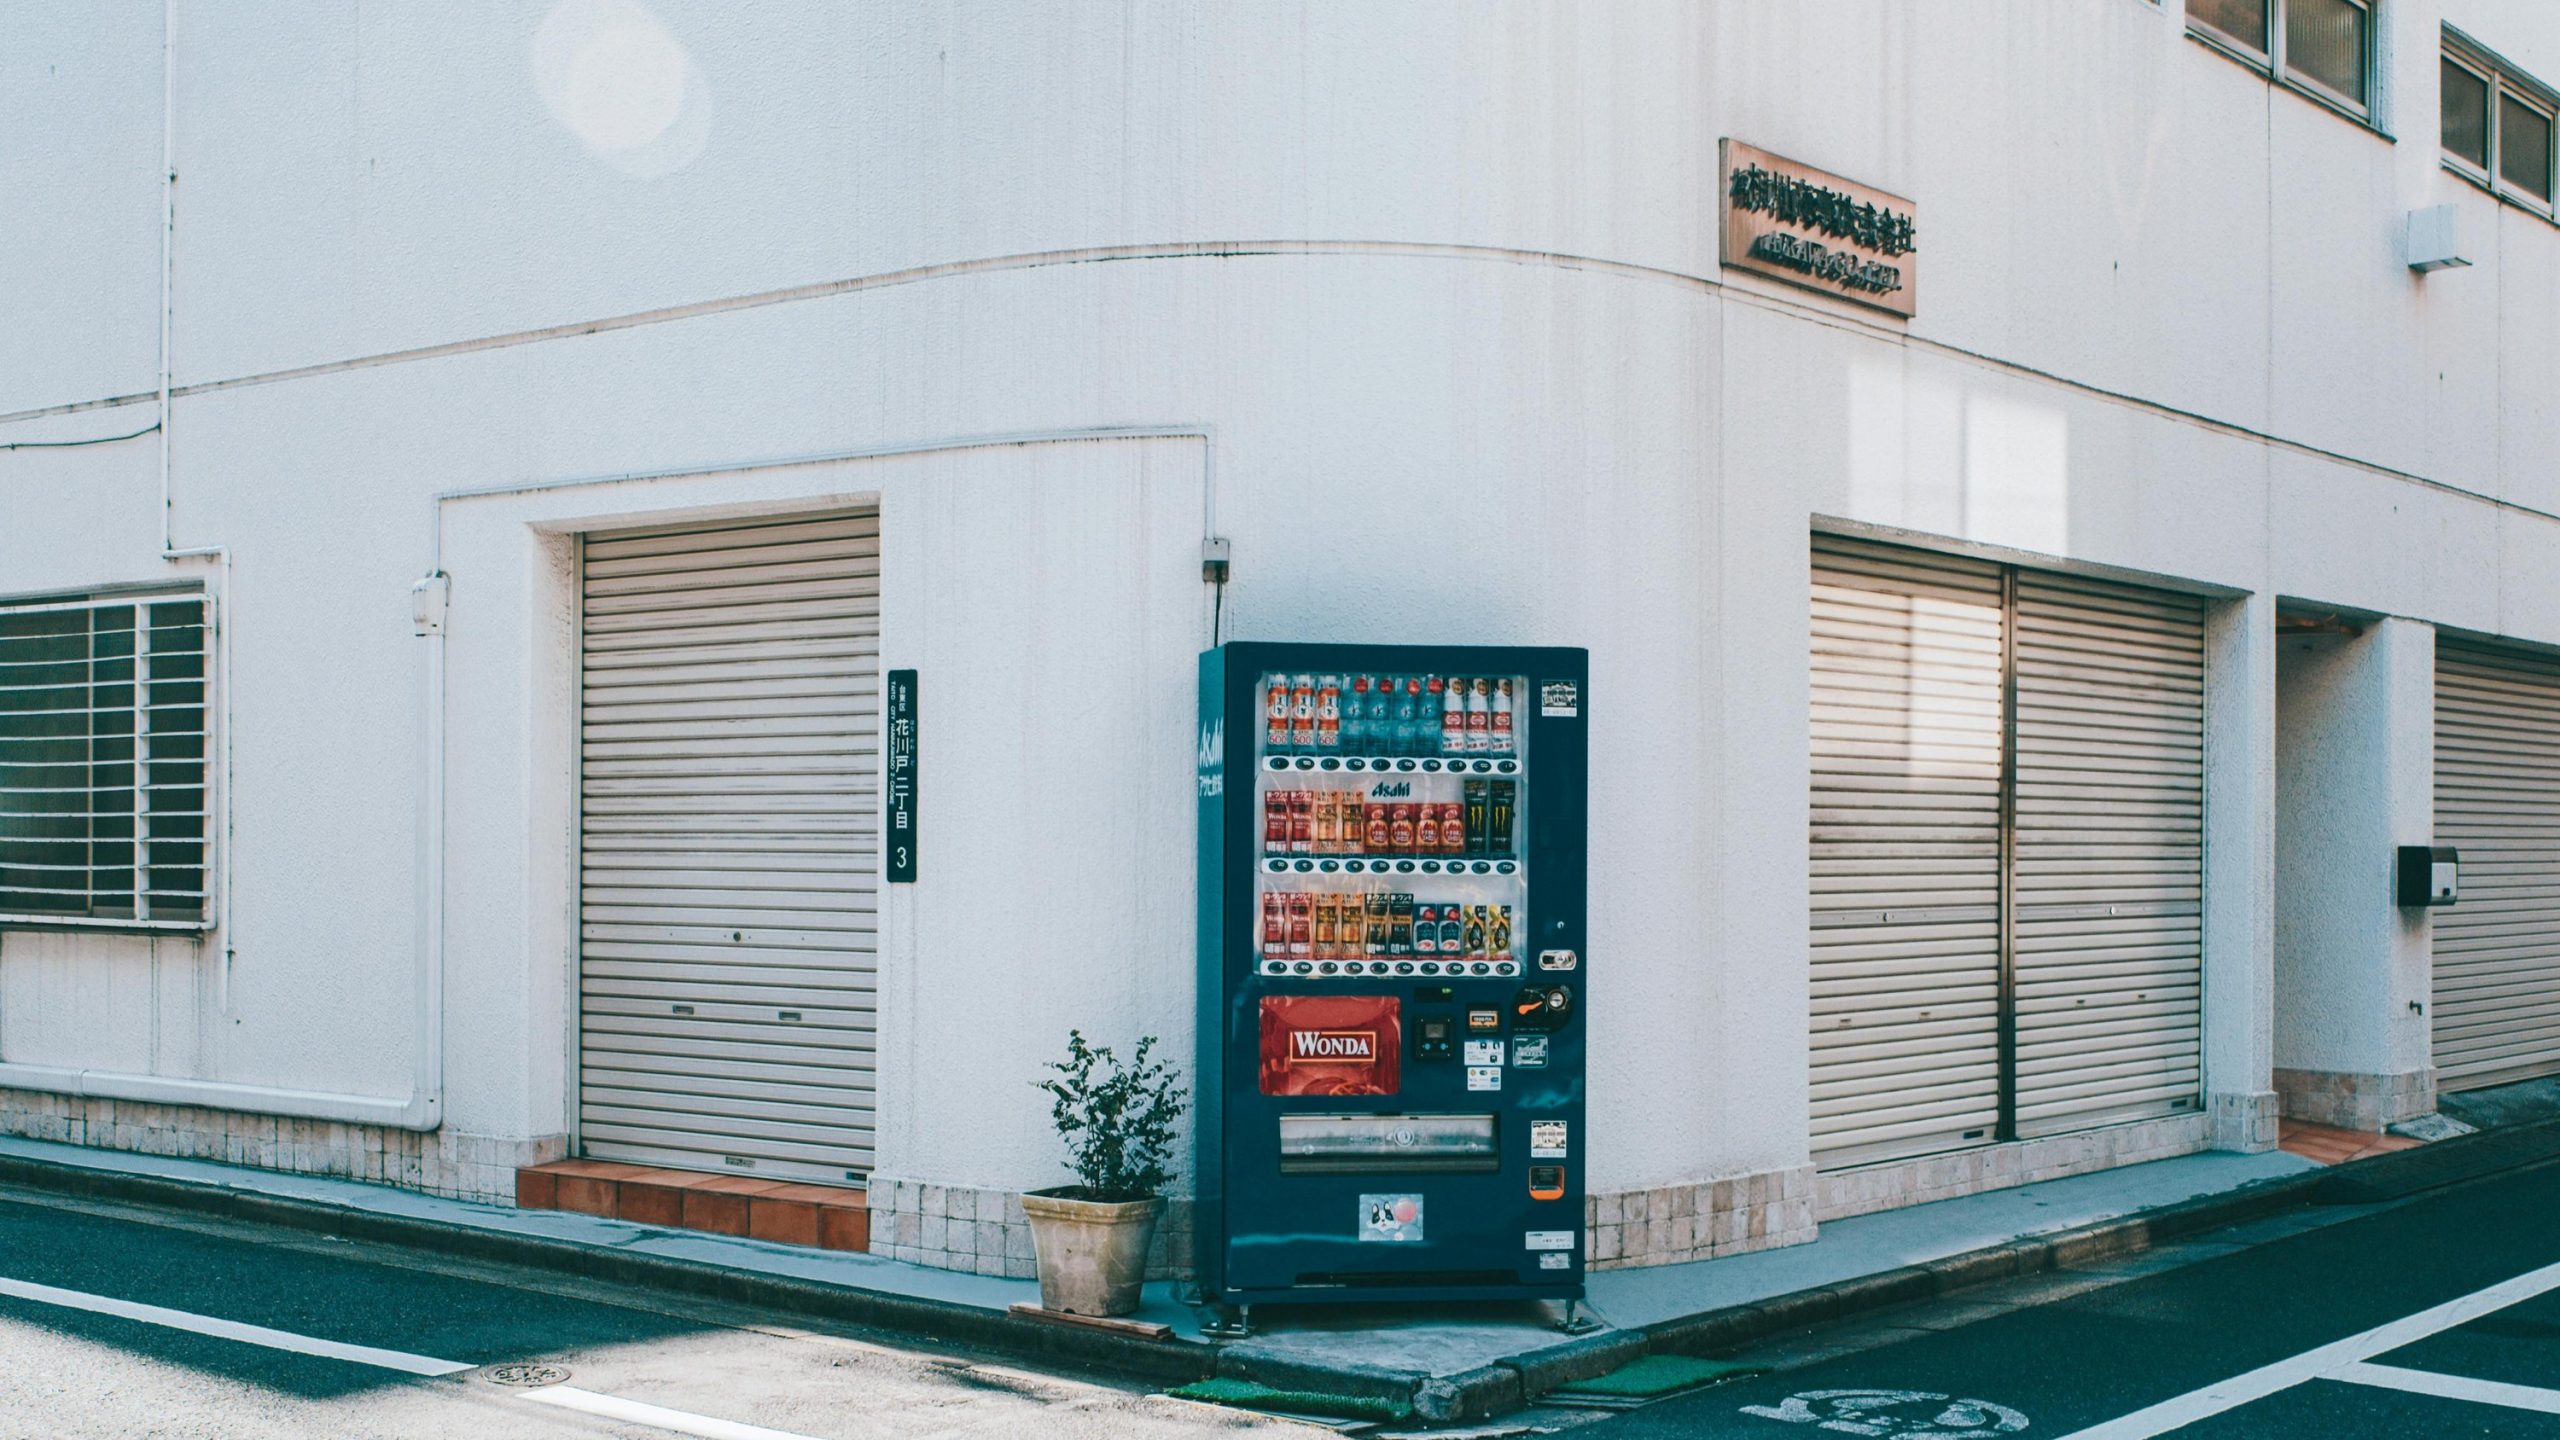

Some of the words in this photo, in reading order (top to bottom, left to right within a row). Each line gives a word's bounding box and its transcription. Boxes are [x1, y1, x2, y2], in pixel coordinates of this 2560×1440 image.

[896, 718, 909, 829] 花川戸二丁目
[1372, 781, 1411, 797] Asahi
[897, 847, 907, 868] 3
[1294, 1031, 1370, 1057] WONDA
